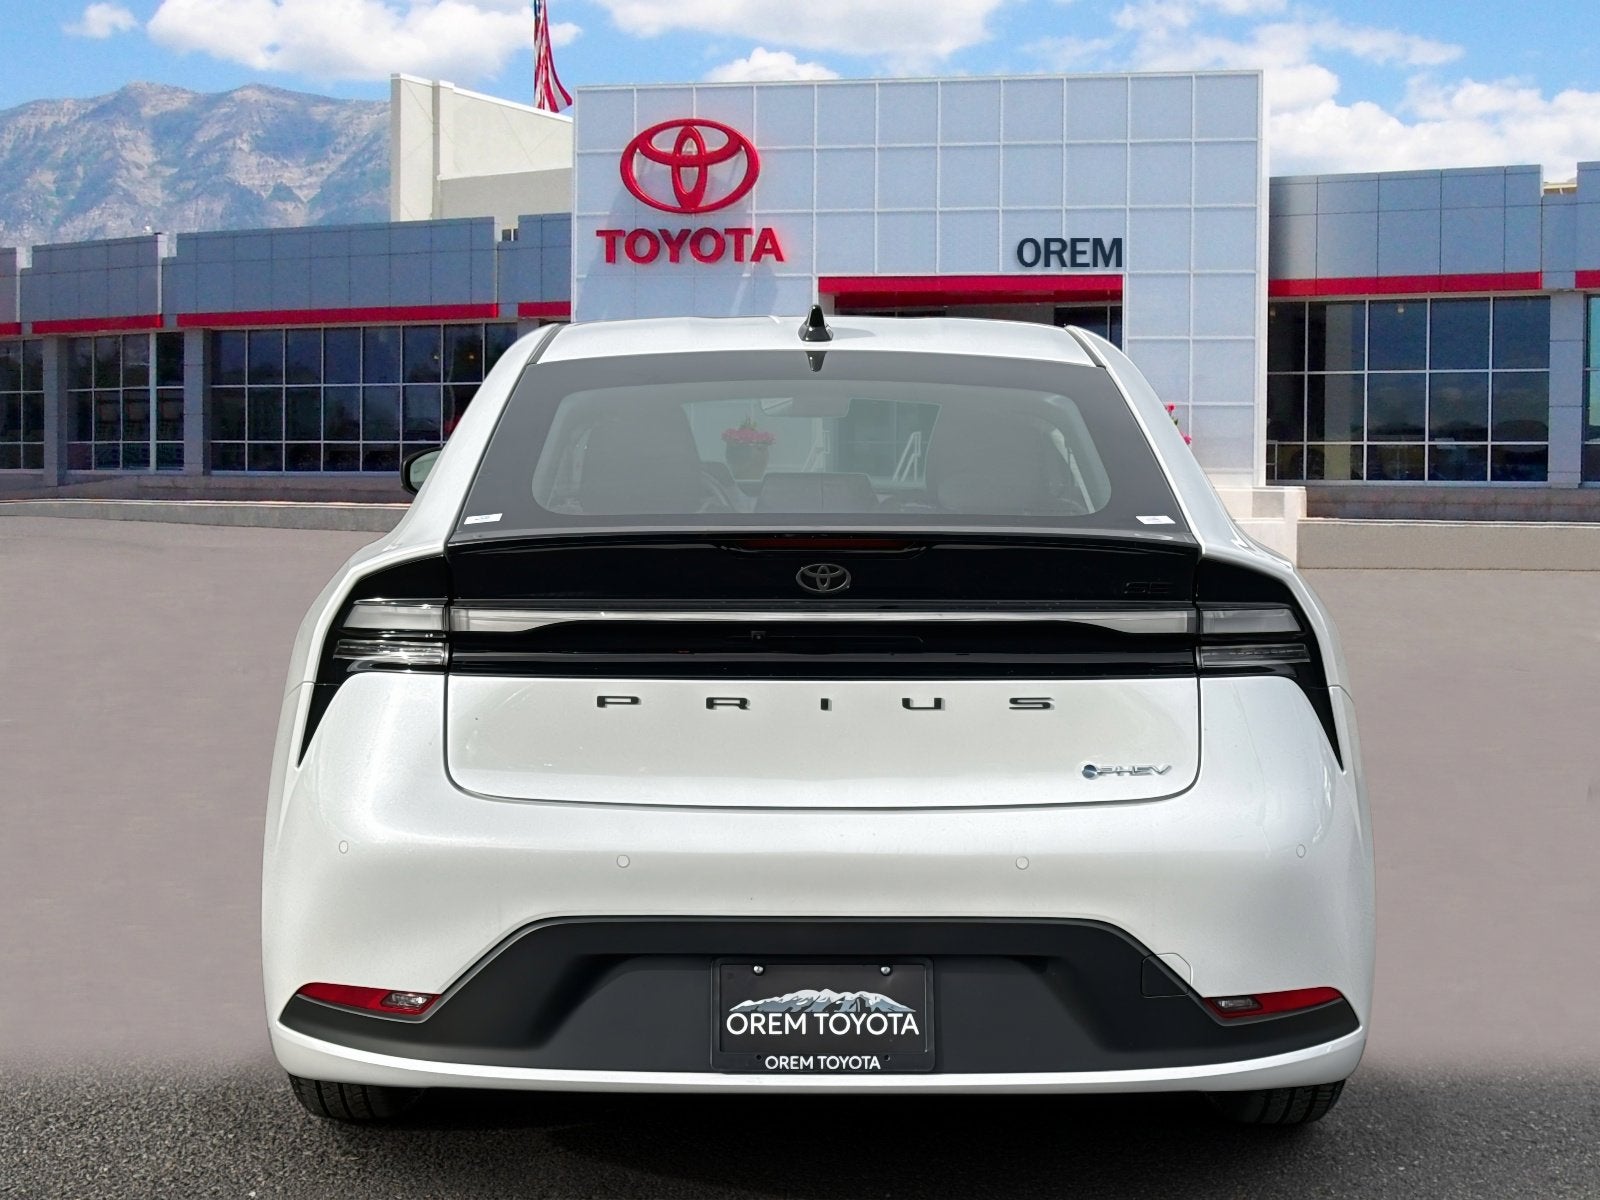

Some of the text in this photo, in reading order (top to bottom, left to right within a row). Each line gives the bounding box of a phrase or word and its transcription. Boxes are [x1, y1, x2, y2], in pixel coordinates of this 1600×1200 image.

[596, 226, 785, 264] TOYOTA
[1016, 238, 1123, 268] OREM
[596, 695, 1054, 712] PRIUS
[1097, 764, 1172, 777] PHEV
[726, 1012, 920, 1036] OREM TOYOTA
[764, 1055, 881, 1070] OREM TOYOTA
